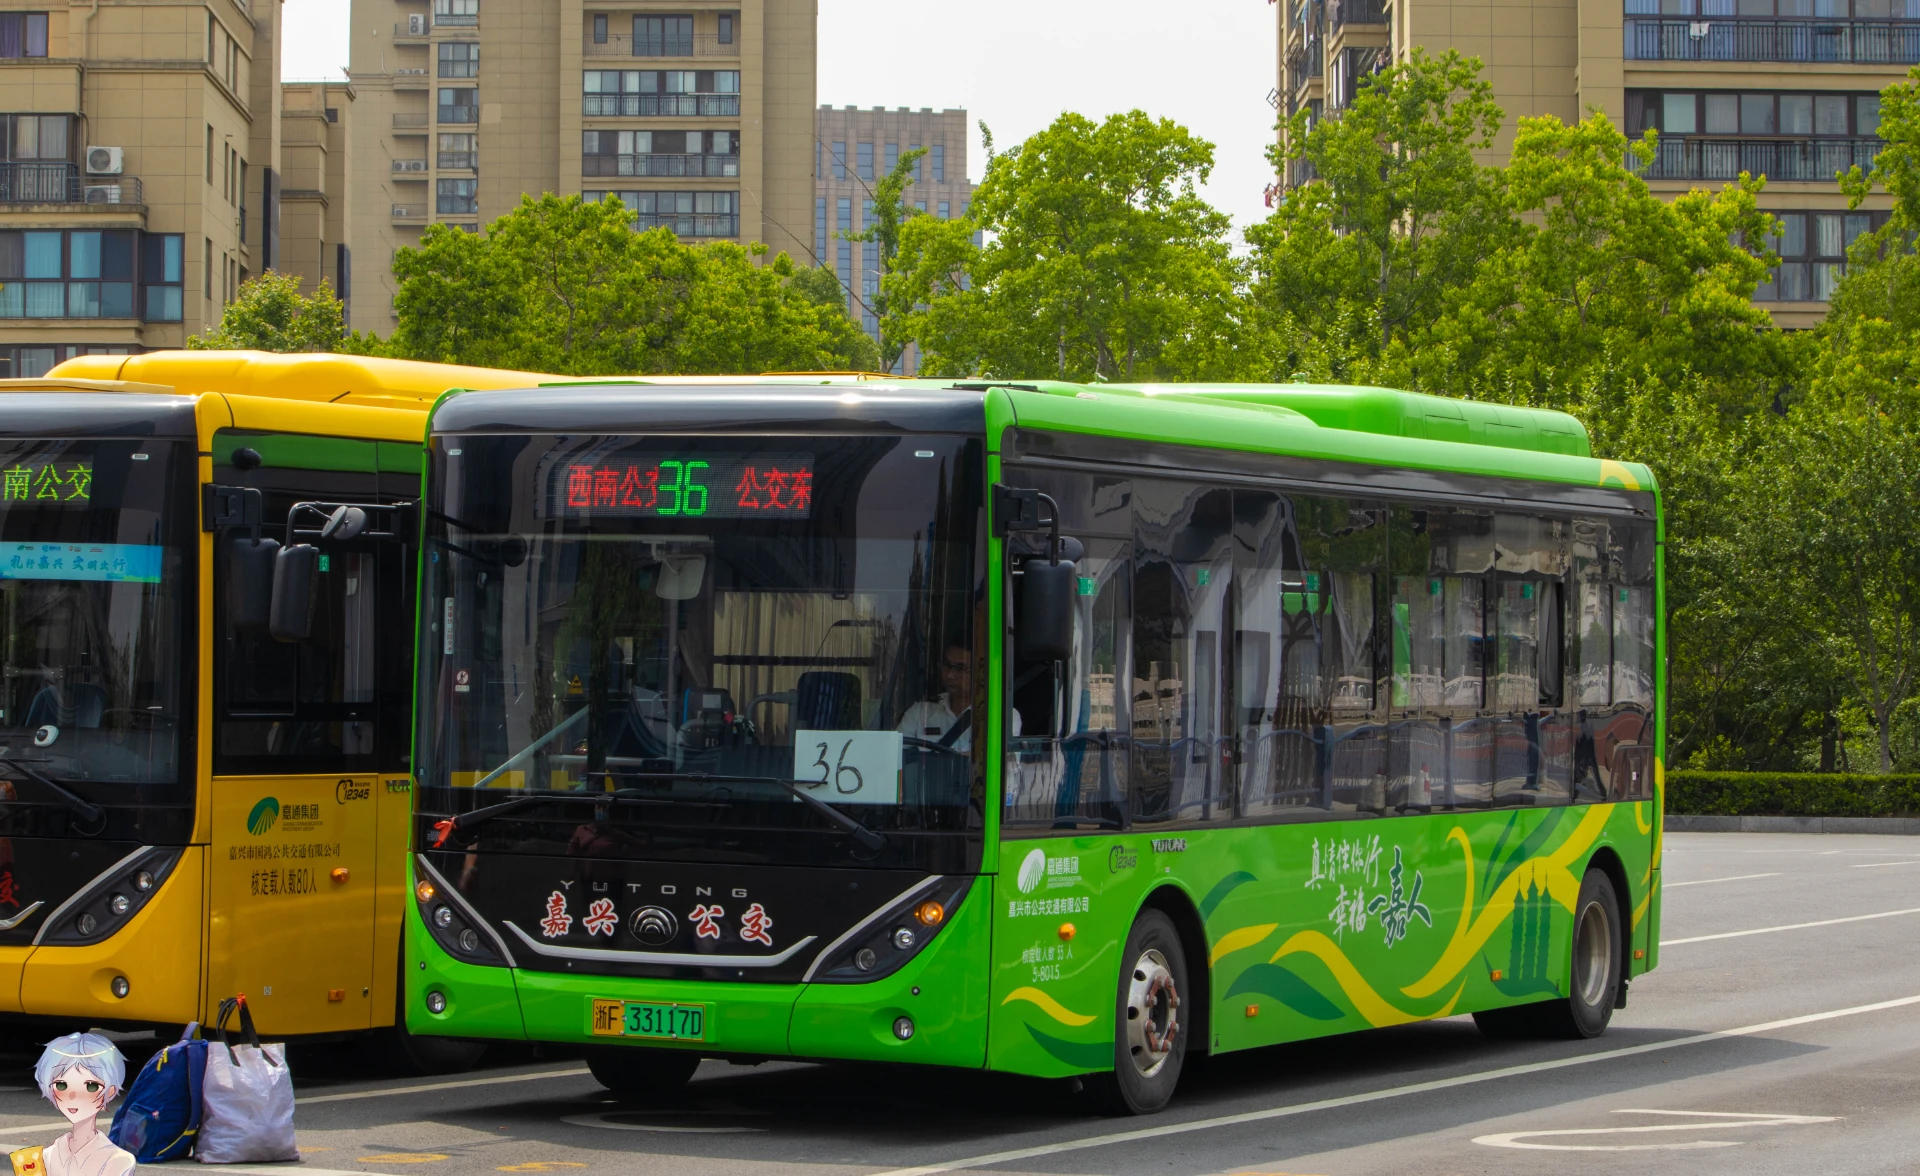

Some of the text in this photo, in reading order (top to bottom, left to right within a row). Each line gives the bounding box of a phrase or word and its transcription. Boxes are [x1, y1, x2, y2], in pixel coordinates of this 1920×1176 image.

[4, 464, 92, 500] 南公交
[657, 461, 709, 515] 36
[72, 556, 126, 571] 文明出行
[807, 739, 863, 794] 36
[344, 789, 370, 800] 12345
[282, 804, 319, 820] 嘉通集团
[229, 843, 340, 860] 嘉兴市国鸿公共交通有限公司
[1047, 856, 1079, 875] 嘉通集团
[1116, 856, 1137, 869] 12345
[251, 868, 317, 896] 核定载人数80人
[560, 880, 748, 898] YUTONG
[1009, 897, 1089, 918] 嘉兴市公共交通有限公司
[1032, 965, 1060, 982] 5-8015
